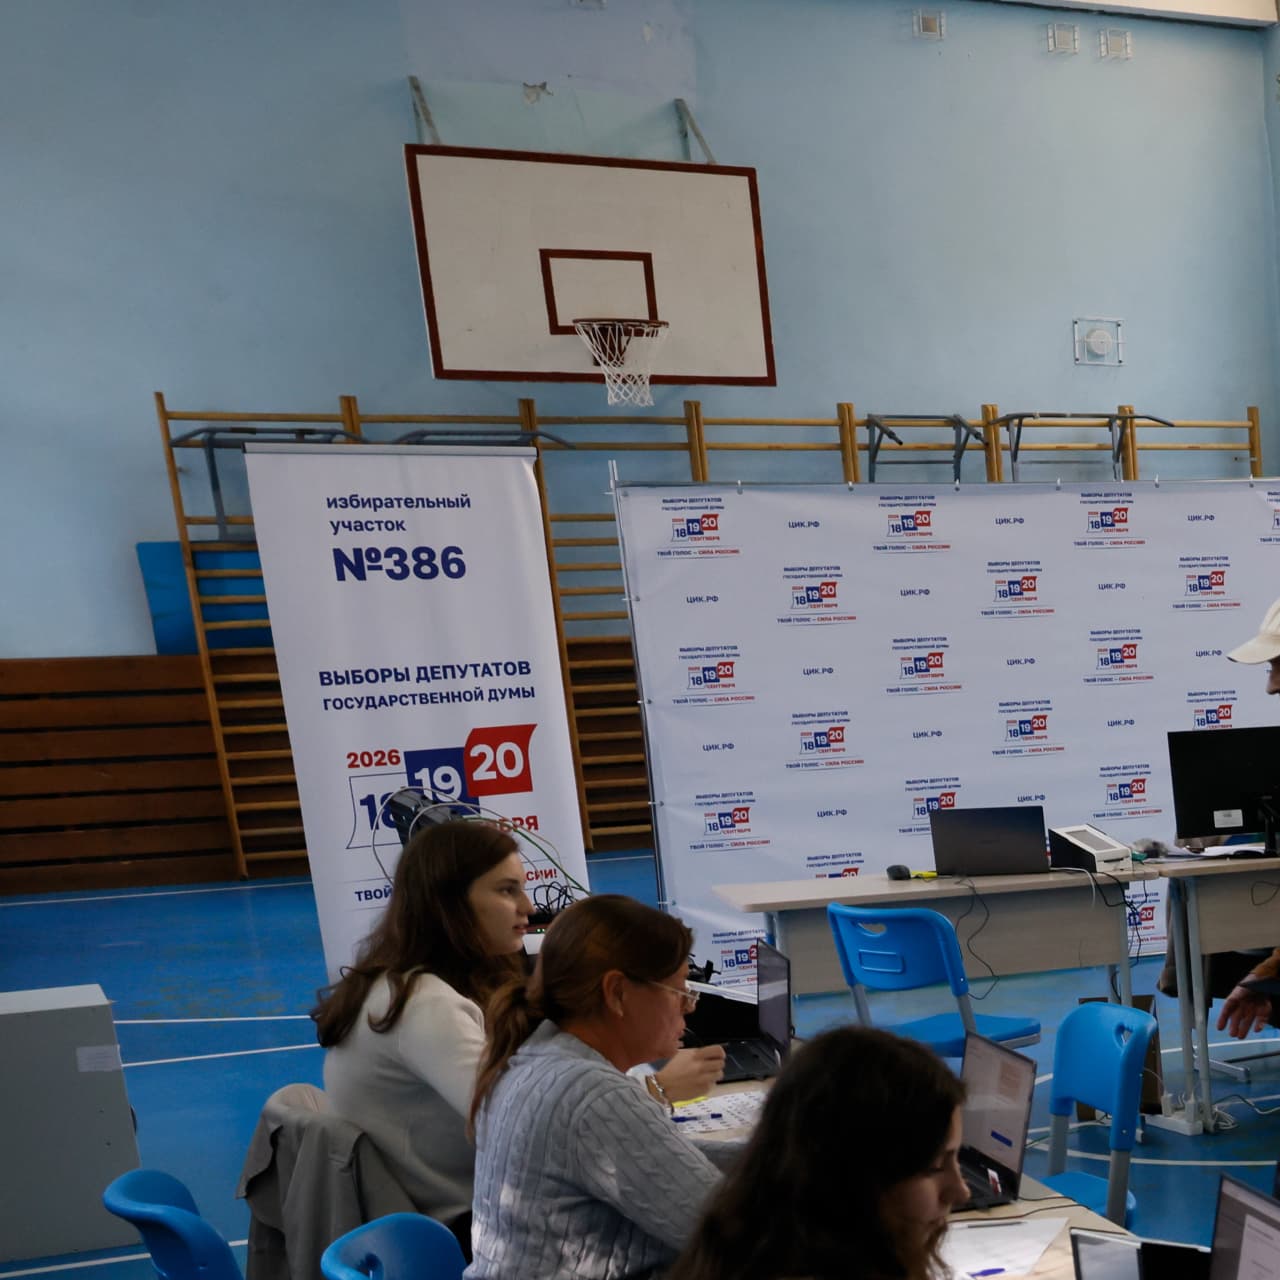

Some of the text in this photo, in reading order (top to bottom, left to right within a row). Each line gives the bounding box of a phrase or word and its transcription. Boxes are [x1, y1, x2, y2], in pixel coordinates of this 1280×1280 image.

[326, 494, 471, 512] избирательный
[902, 518, 914, 529] 19
[915, 514, 929, 524] 20
[1101, 515, 1112, 525] 19
[1113, 511, 1126, 521] 20
[329, 520, 407, 536] участок
[675, 517, 716, 538] 18 19 20
[332, 546, 466, 581] №386
[1009, 584, 1020, 594] 19
[1021, 579, 1035, 589] 20
[1199, 578, 1209, 588] 19
[1211, 574, 1223, 584] 20
[795, 585, 835, 606] 18 19 20
[1110, 651, 1121, 662] 19
[1122, 647, 1135, 657] 20
[915, 660, 926, 671] 19
[928, 656, 942, 666] 20
[319, 660, 531, 686] ВЫБОРЫ ДЕПУТАТОВ
[691, 665, 732, 686] 18 19 20
[323, 686, 536, 710] ГОСУДАРСТВЕННОЙ ДУМЫ
[1207, 712, 1217, 722] 19
[1218, 708, 1230, 717] 20
[1020, 723, 1031, 733] 19
[1032, 718, 1045, 728] 20
[803, 730, 843, 751] 18 19 20
[346, 749, 401, 769] 2026
[414, 766, 462, 803] 19
[469, 741, 524, 781] 20
[1120, 787, 1130, 797] 19
[1131, 782, 1143, 792] 20
[927, 801, 939, 811] 19
[940, 796, 954, 806] 20
[707, 811, 748, 832] 18 19 20
[1141, 910, 1152, 919] 20
[737, 952, 749, 962] 19
